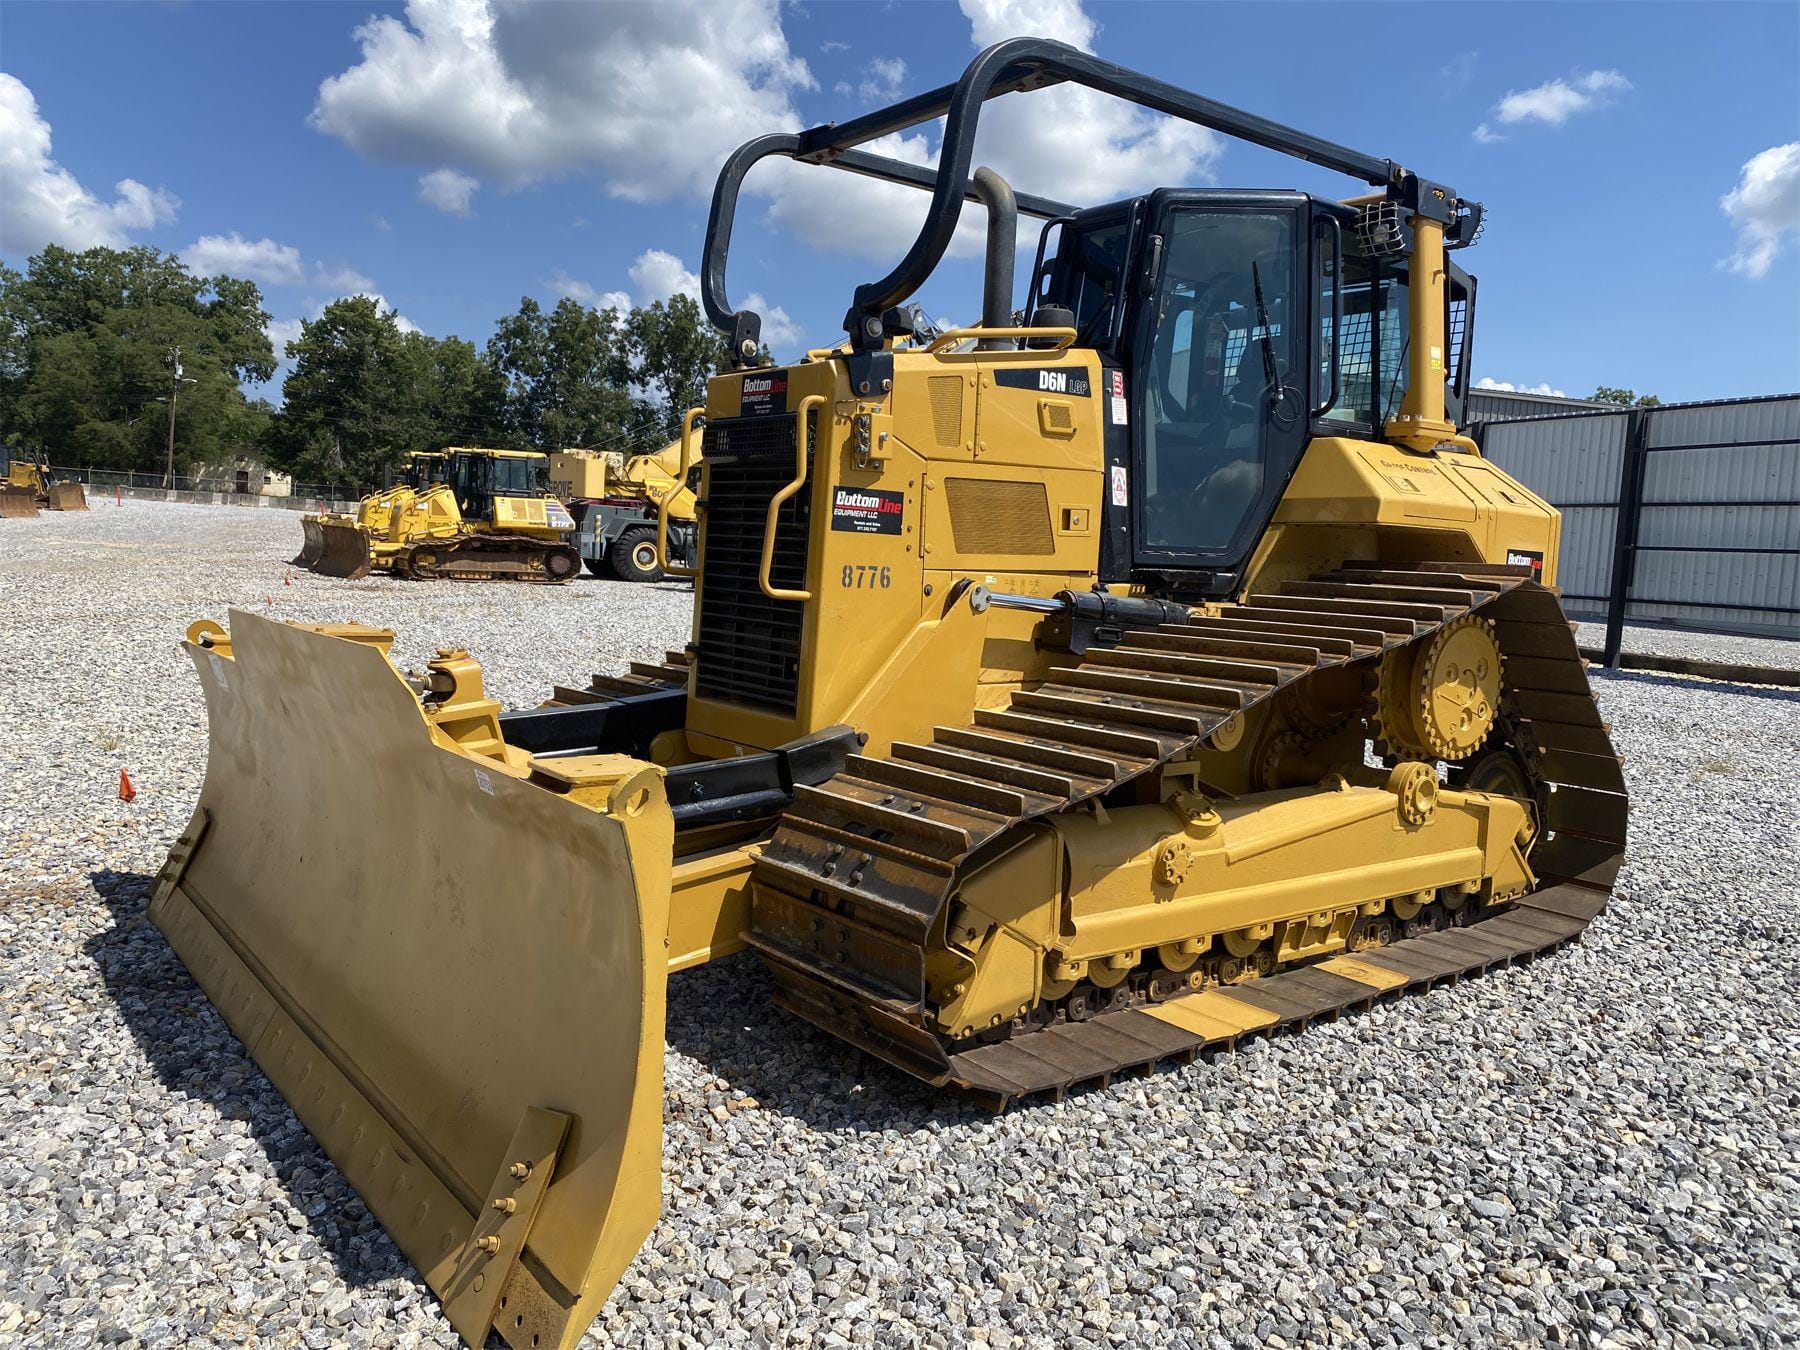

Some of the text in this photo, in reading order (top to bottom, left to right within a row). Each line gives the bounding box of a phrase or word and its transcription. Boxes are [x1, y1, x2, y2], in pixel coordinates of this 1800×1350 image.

[1039, 370, 1066, 392] D6N
[1069, 379, 1088, 395] LGP
[834, 508, 867, 518] EQUIPMENT
[836, 490, 902, 513] BottomLine
[842, 565, 891, 589] 8776
